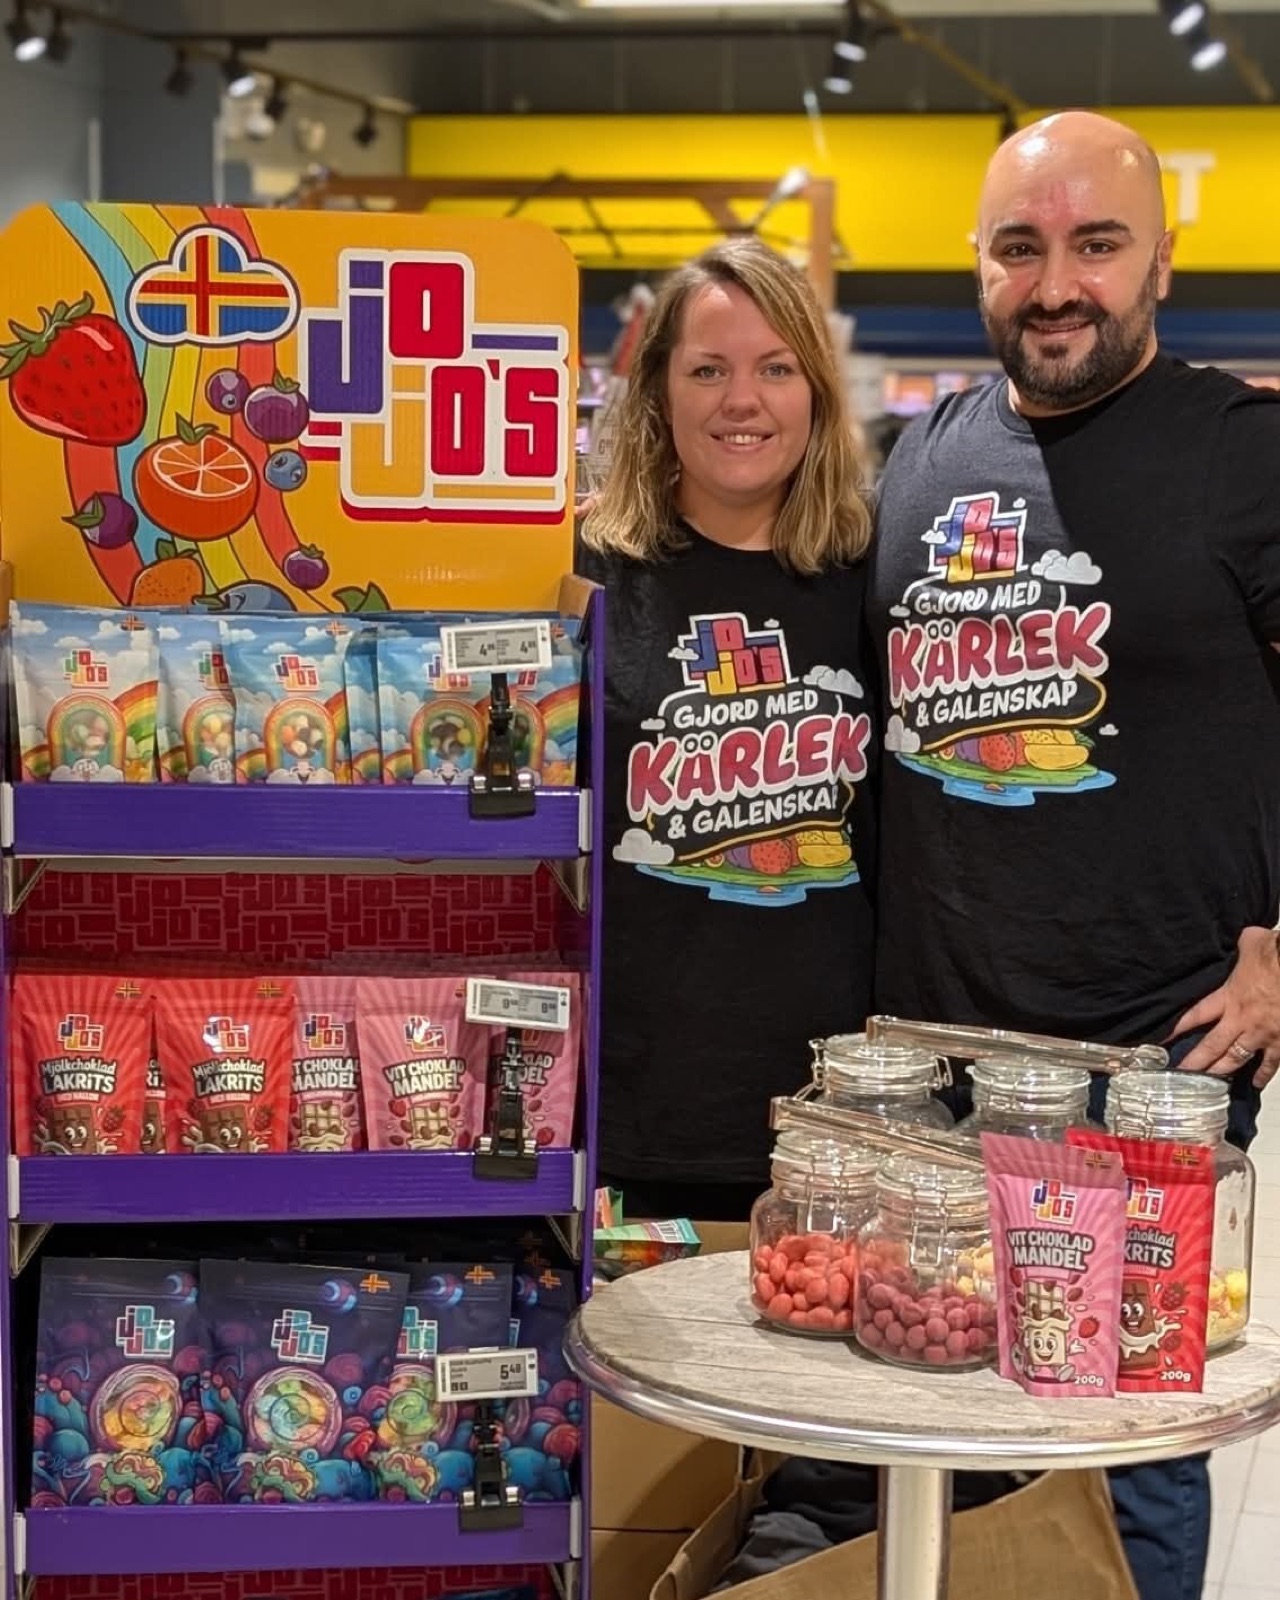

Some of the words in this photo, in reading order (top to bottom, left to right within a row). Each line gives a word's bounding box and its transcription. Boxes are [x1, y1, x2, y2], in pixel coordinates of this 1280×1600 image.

[914, 590, 988, 615] GJORD
[990, 580, 1041, 610] MED
[887, 602, 1111, 708] KÄRLEK
[673, 699, 759, 728] GJORD
[765, 690, 818, 719] MED
[916, 701, 929, 727] &
[933, 680, 1077, 723] GALENSKAP
[627, 713, 870, 822] KÄRLEK
[667, 815, 686, 839] &
[385, 1064, 408, 1082] VIT
[409, 1058, 464, 1076] CHOKLAD
[394, 1072, 461, 1096] MANDEL
[1008, 1230, 1027, 1247] VIT
[1028, 1230, 1093, 1252] CHOKLAD
[1014, 1246, 1086, 1270] MANDEL
[1074, 1375, 1104, 1388] 200g
[1161, 1371, 1192, 1384] 200g
